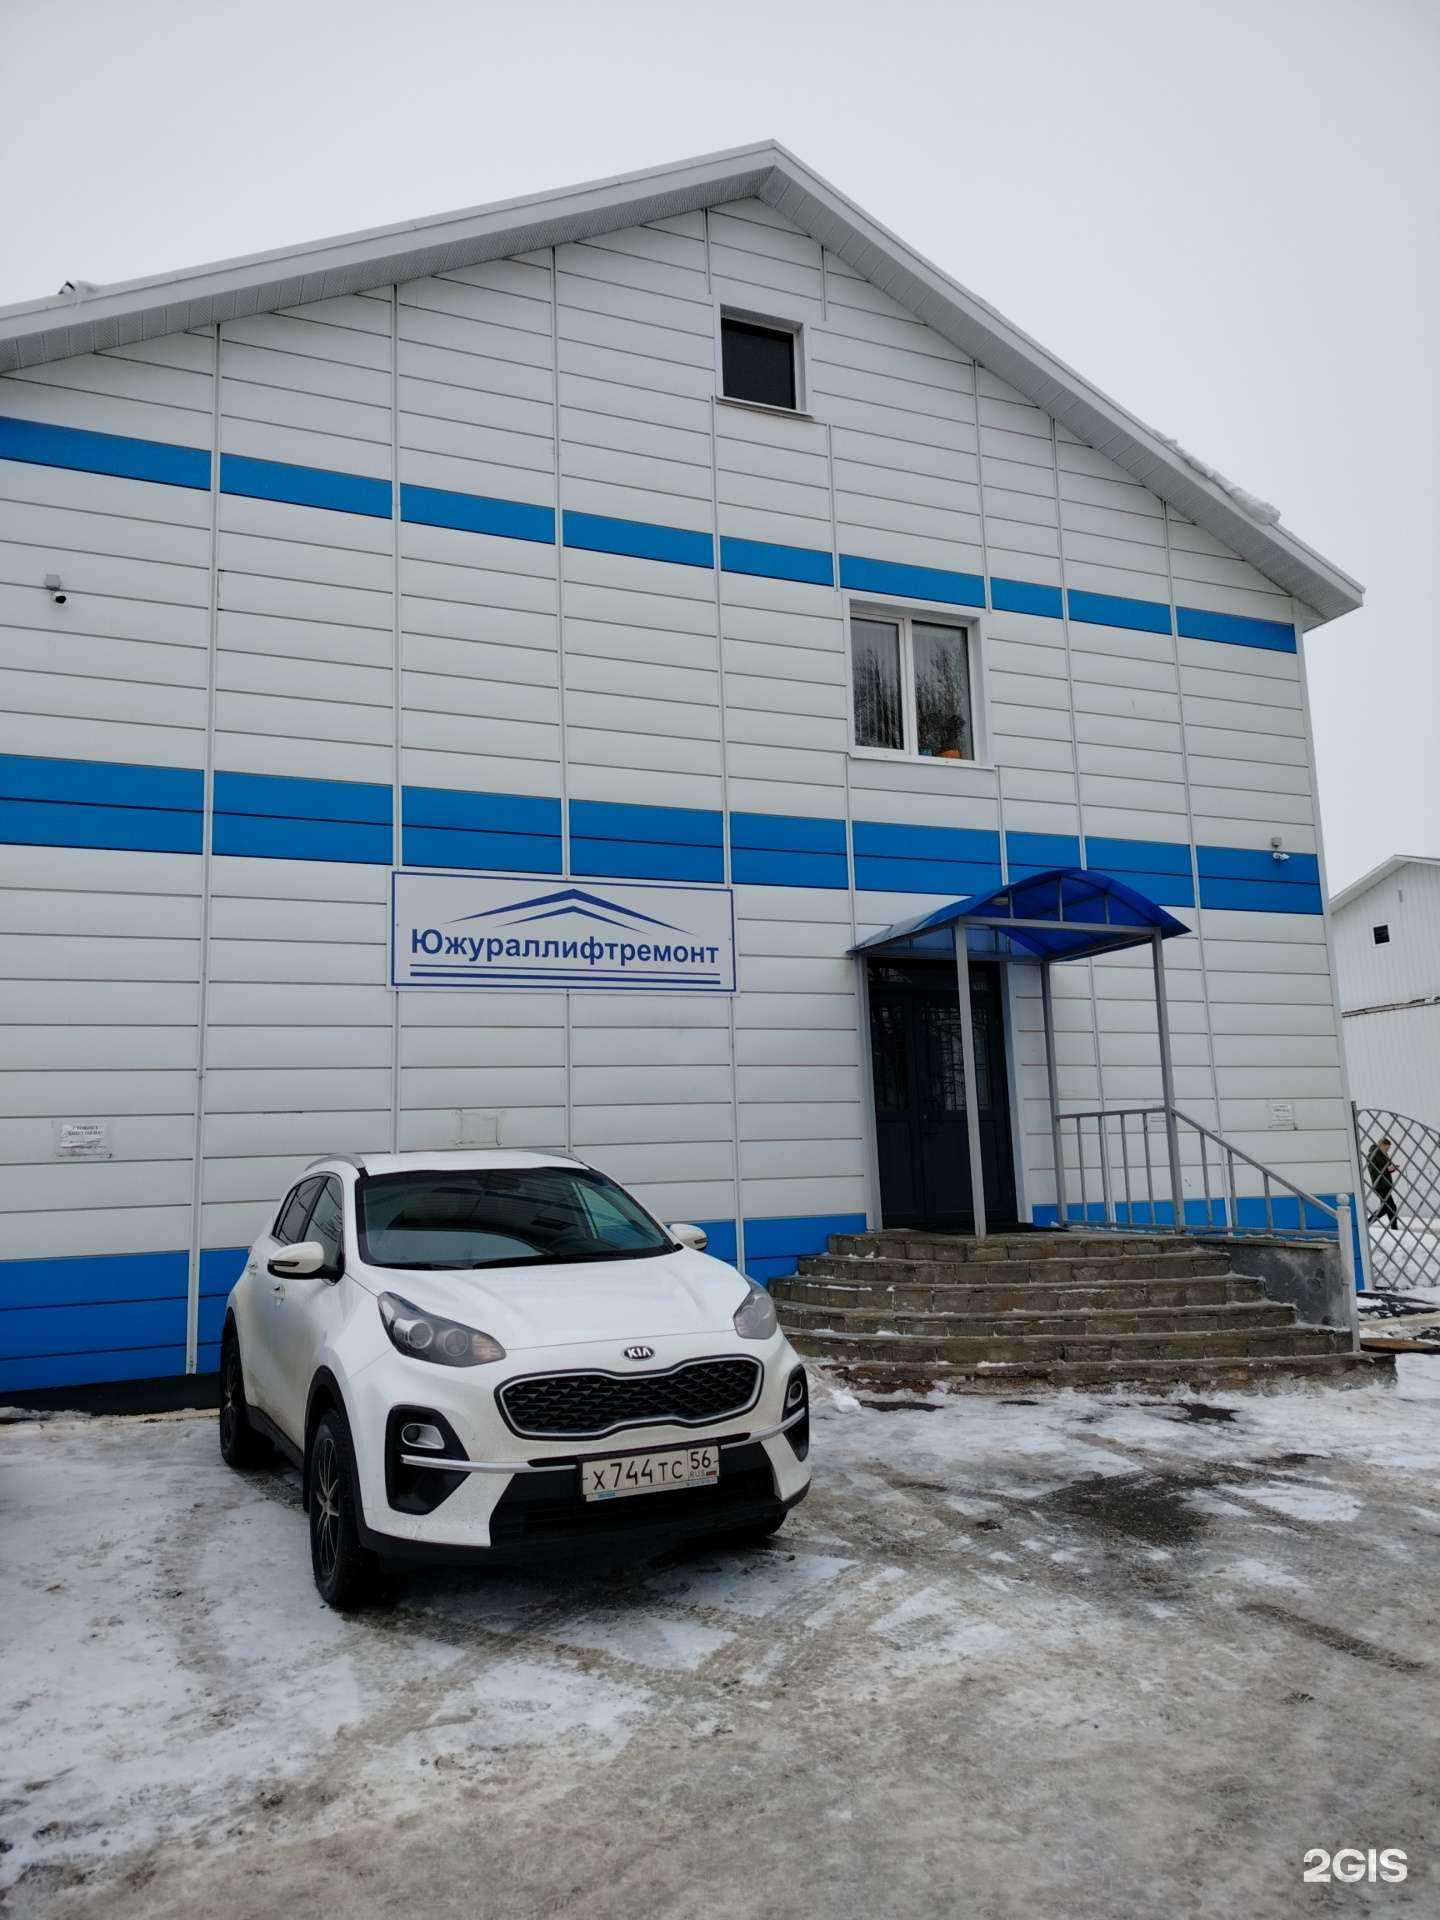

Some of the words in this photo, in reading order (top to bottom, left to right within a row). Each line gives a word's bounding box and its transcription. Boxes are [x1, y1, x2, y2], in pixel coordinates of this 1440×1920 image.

[410, 928, 719, 966] Южураллифтремонт
[627, 1347, 651, 1358] KIA
[689, 1470, 705, 1478] RUS
